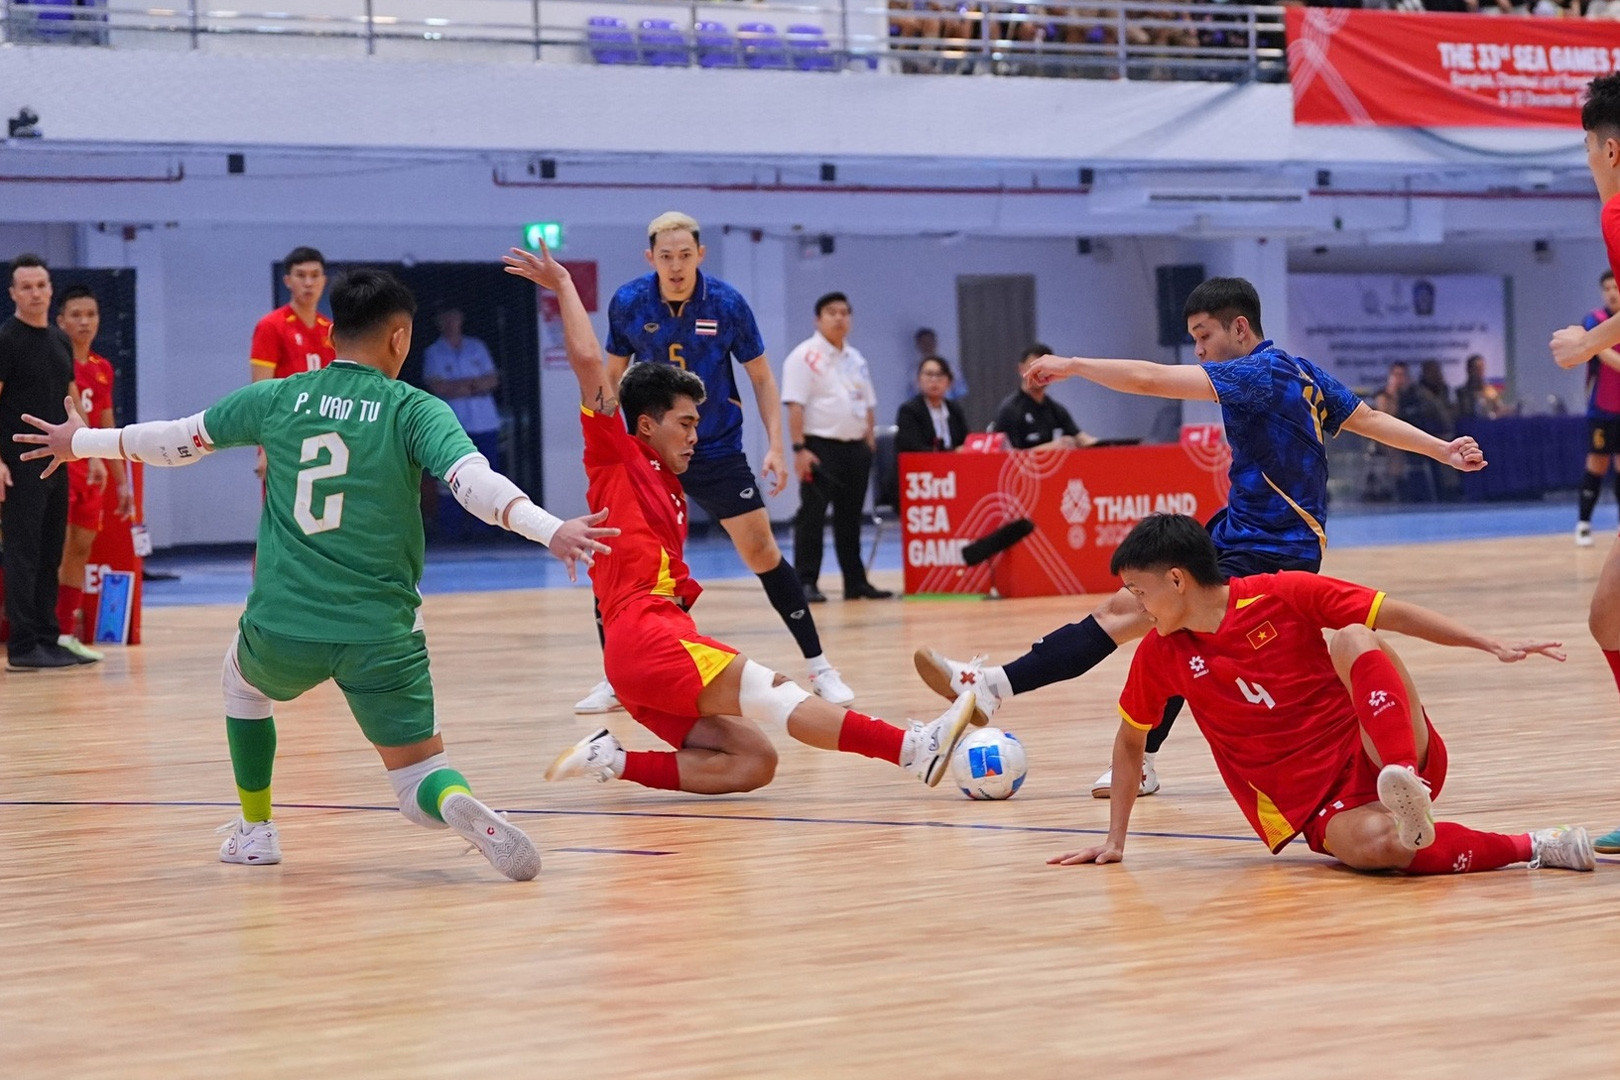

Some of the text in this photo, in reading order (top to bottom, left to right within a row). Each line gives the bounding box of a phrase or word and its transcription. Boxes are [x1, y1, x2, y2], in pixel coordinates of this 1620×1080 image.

[1437, 42, 1476, 70] THE
[1512, 44, 1549, 72] SEA
[668, 342, 687, 370] 5
[81, 387, 94, 413] 6
[294, 391, 381, 423] P. VAN TU
[293, 431, 350, 536] 2
[905, 471, 956, 500] 33rd
[906, 505, 950, 534] SEA
[1093, 492, 1198, 522] THAILAND
[908, 538, 970, 567] GAME
[1234, 676, 1276, 710] 4
